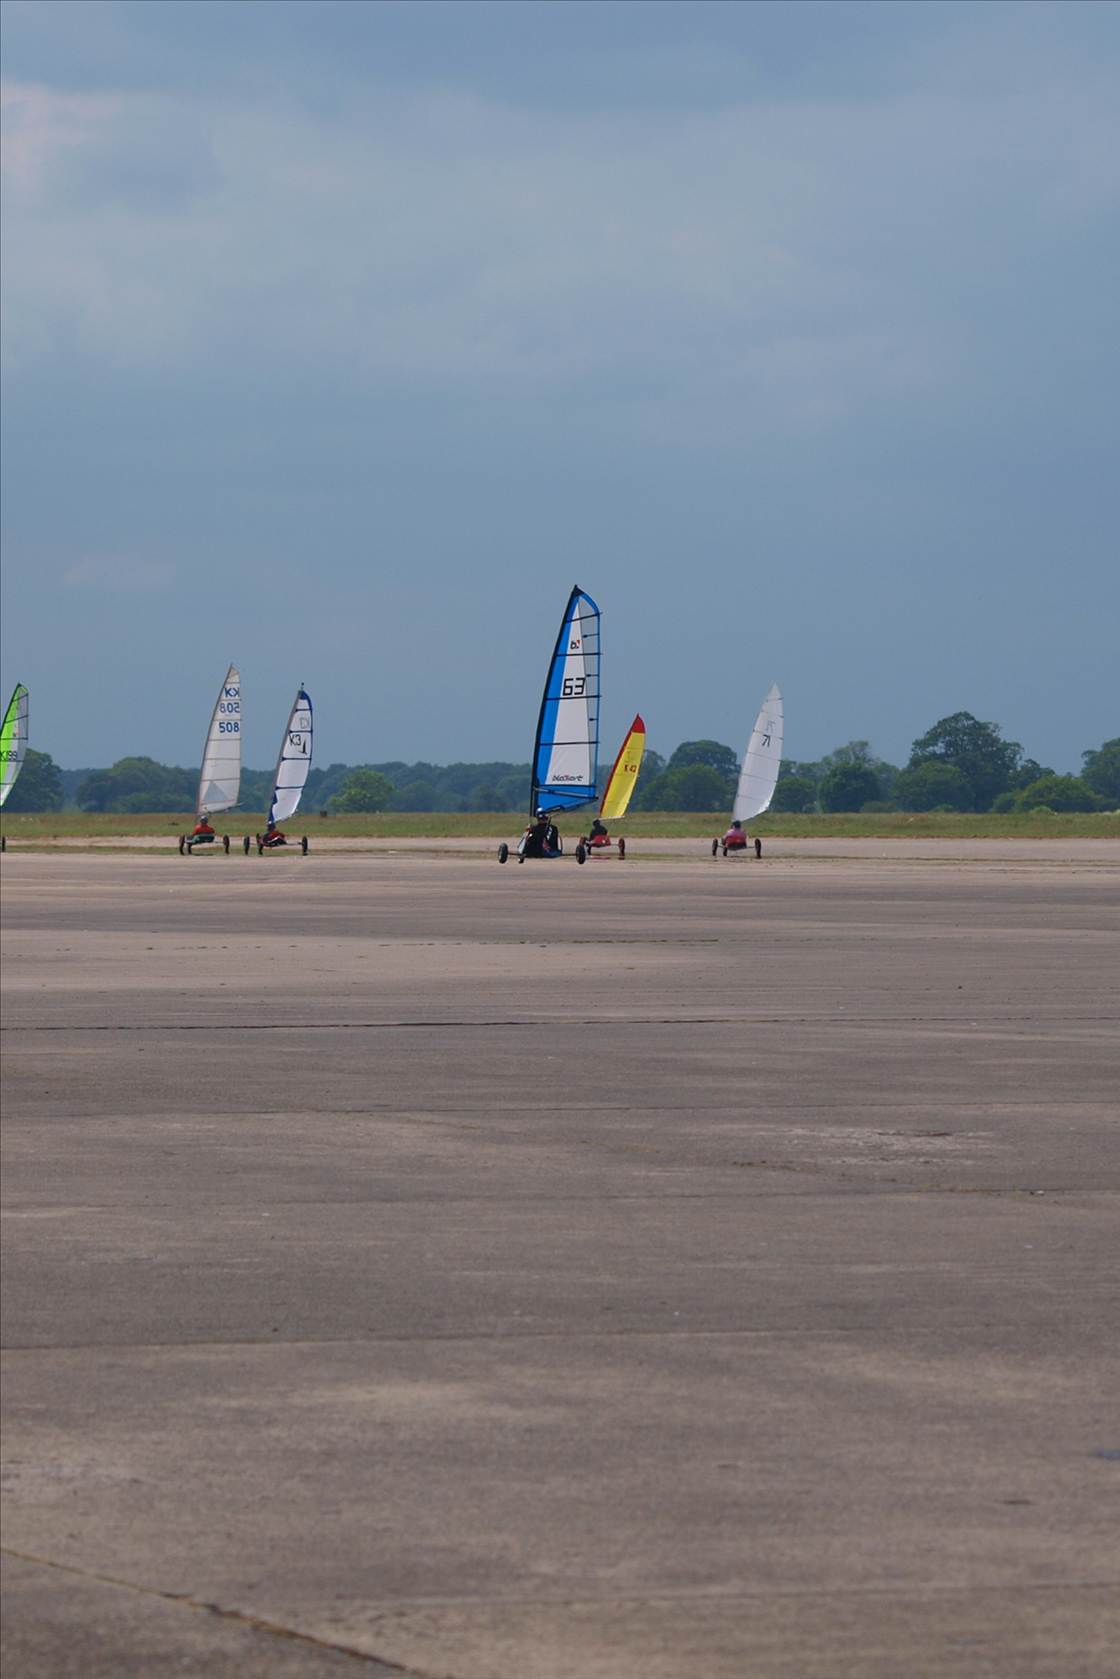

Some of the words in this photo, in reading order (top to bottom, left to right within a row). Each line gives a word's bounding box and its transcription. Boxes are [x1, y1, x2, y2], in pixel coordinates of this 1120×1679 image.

[562, 677, 586, 696] 63
[218, 721, 240, 733] 508
[289, 734, 301, 746] K3
